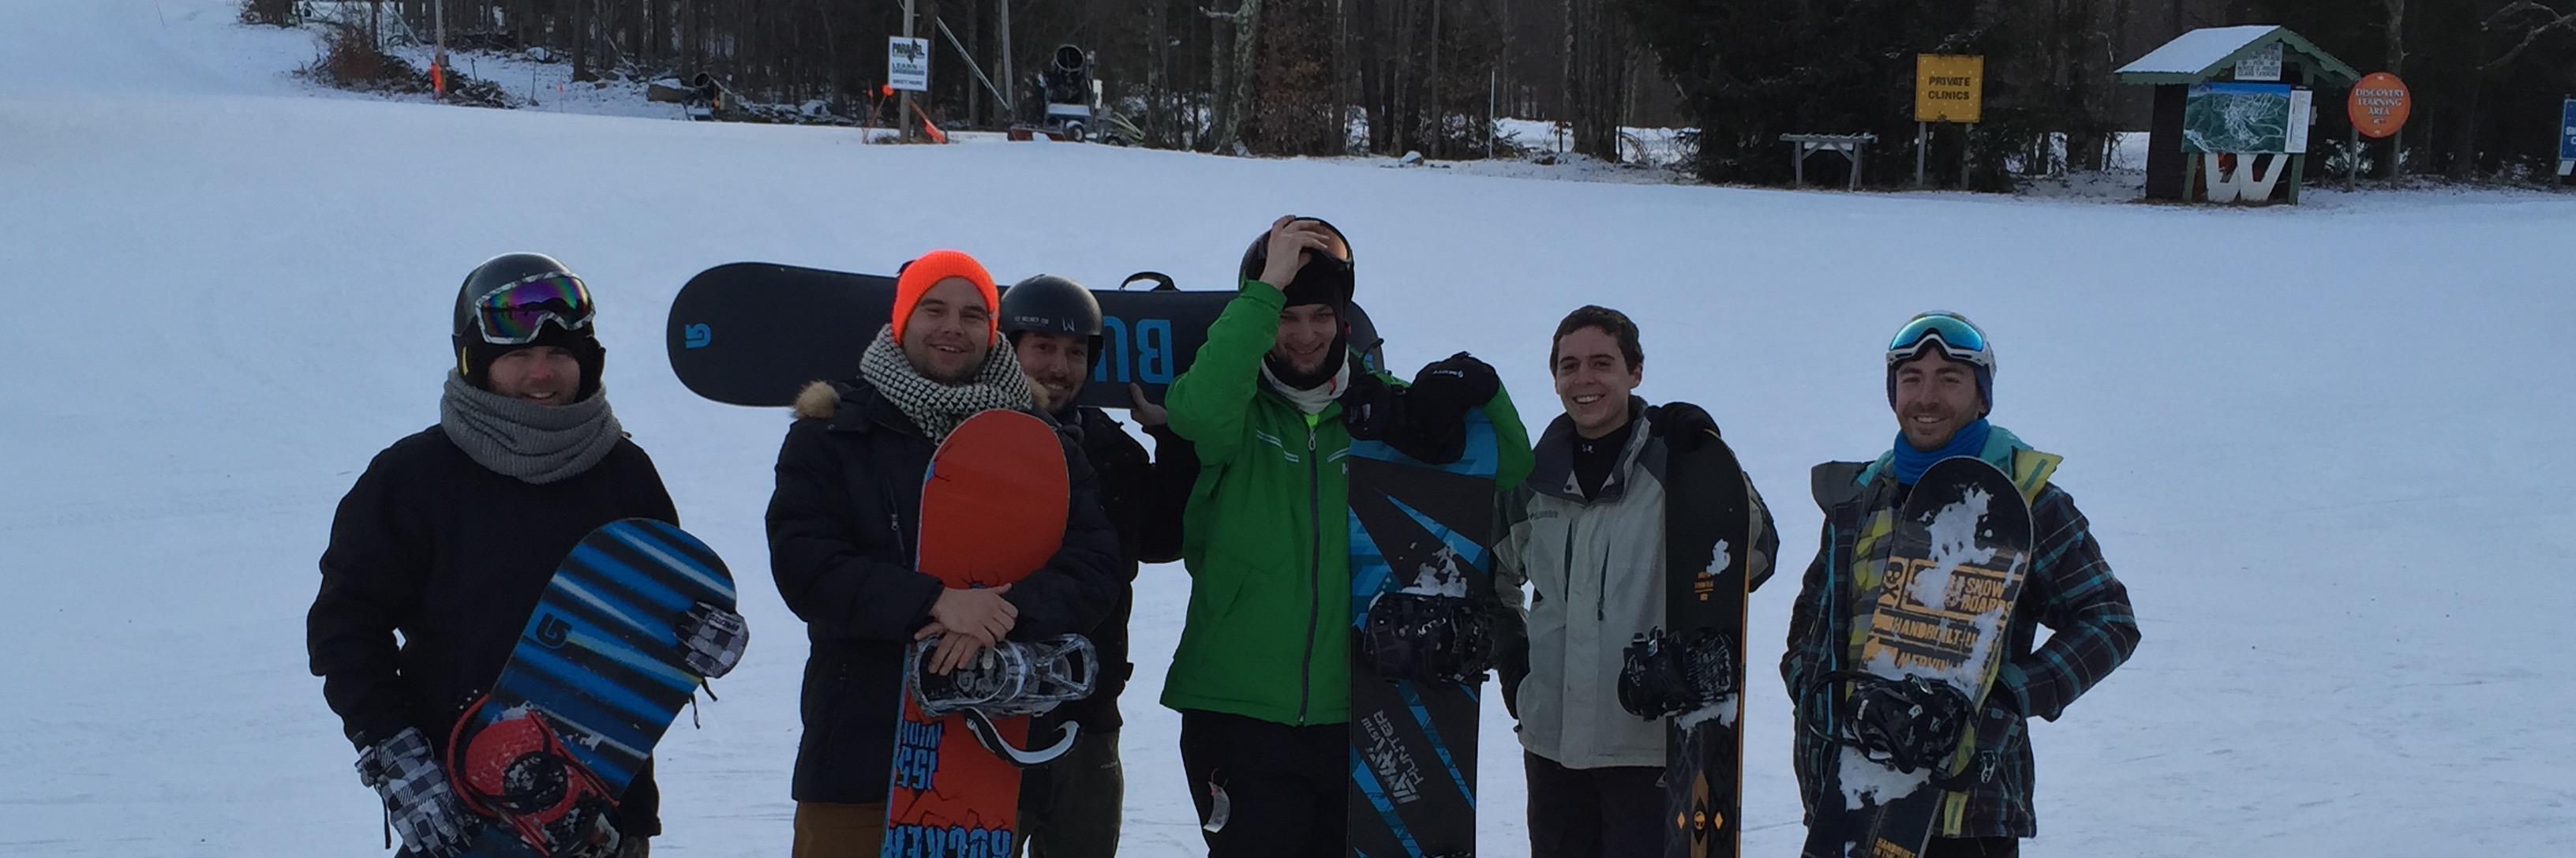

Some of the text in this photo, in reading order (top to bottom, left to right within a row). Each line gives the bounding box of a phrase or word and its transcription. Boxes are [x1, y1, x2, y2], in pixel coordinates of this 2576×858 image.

[1928, 76, 1971, 87] PRIVATE
[1928, 91, 1970, 100] CLINICS
[2356, 88, 2404, 97] DISCOVERY
[1965, 579, 2005, 599] SNOW
[1373, 709, 1424, 785] HUNTER
[897, 746, 938, 789] 155
